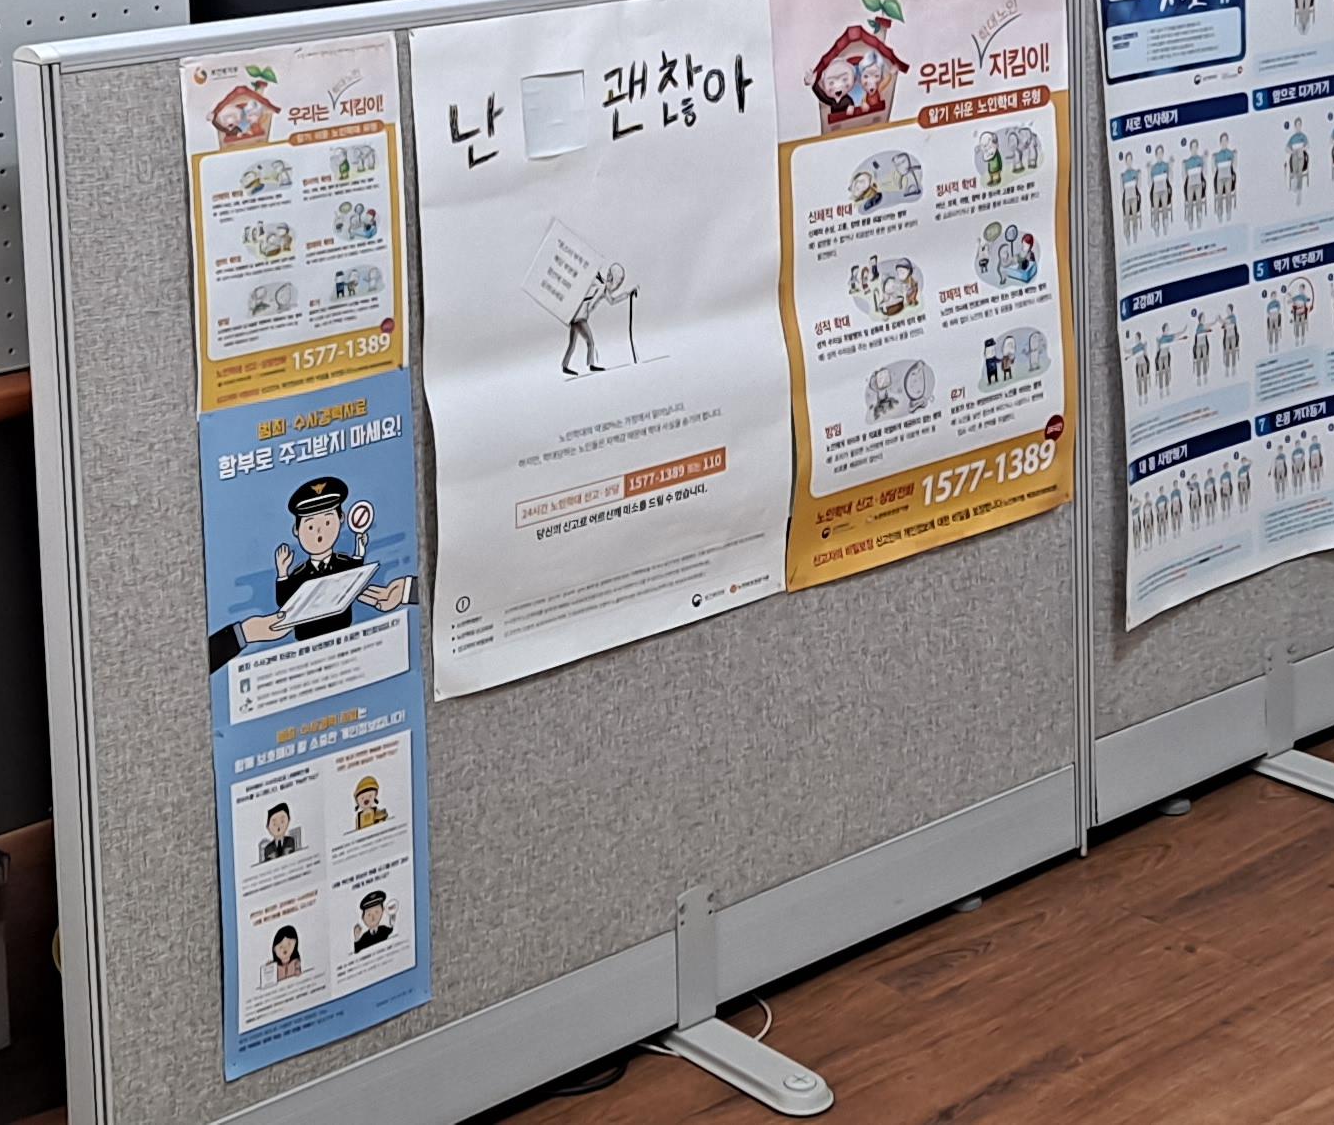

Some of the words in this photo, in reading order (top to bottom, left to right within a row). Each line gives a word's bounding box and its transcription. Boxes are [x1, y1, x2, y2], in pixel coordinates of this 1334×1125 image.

[917, 57, 976, 93] 우리는
[989, 42, 1051, 79] 지킴이!
[288, 104, 329, 125] 우리는
[449, 92, 505, 169] 난
[603, 50, 753, 141] 괜찮아
[929, 104, 949, 124] 알기
[954, 100, 974, 119] 쉬운
[977, 94, 1018, 115] 노인학대
[1256, 91, 1264, 107] 3
[1256, 261, 1264, 277] 5
[293, 332, 391, 370] 1577-1389
[1258, 417, 1266, 432] 7
[218, 448, 274, 480] 함부로
[278, 428, 345, 465] 주고받지
[350, 414, 403, 449] 마세요!
[628, 463, 685, 491] 1577-1389
[703, 454, 723, 472] 110
[922, 439, 1056, 506] 1577-1389
